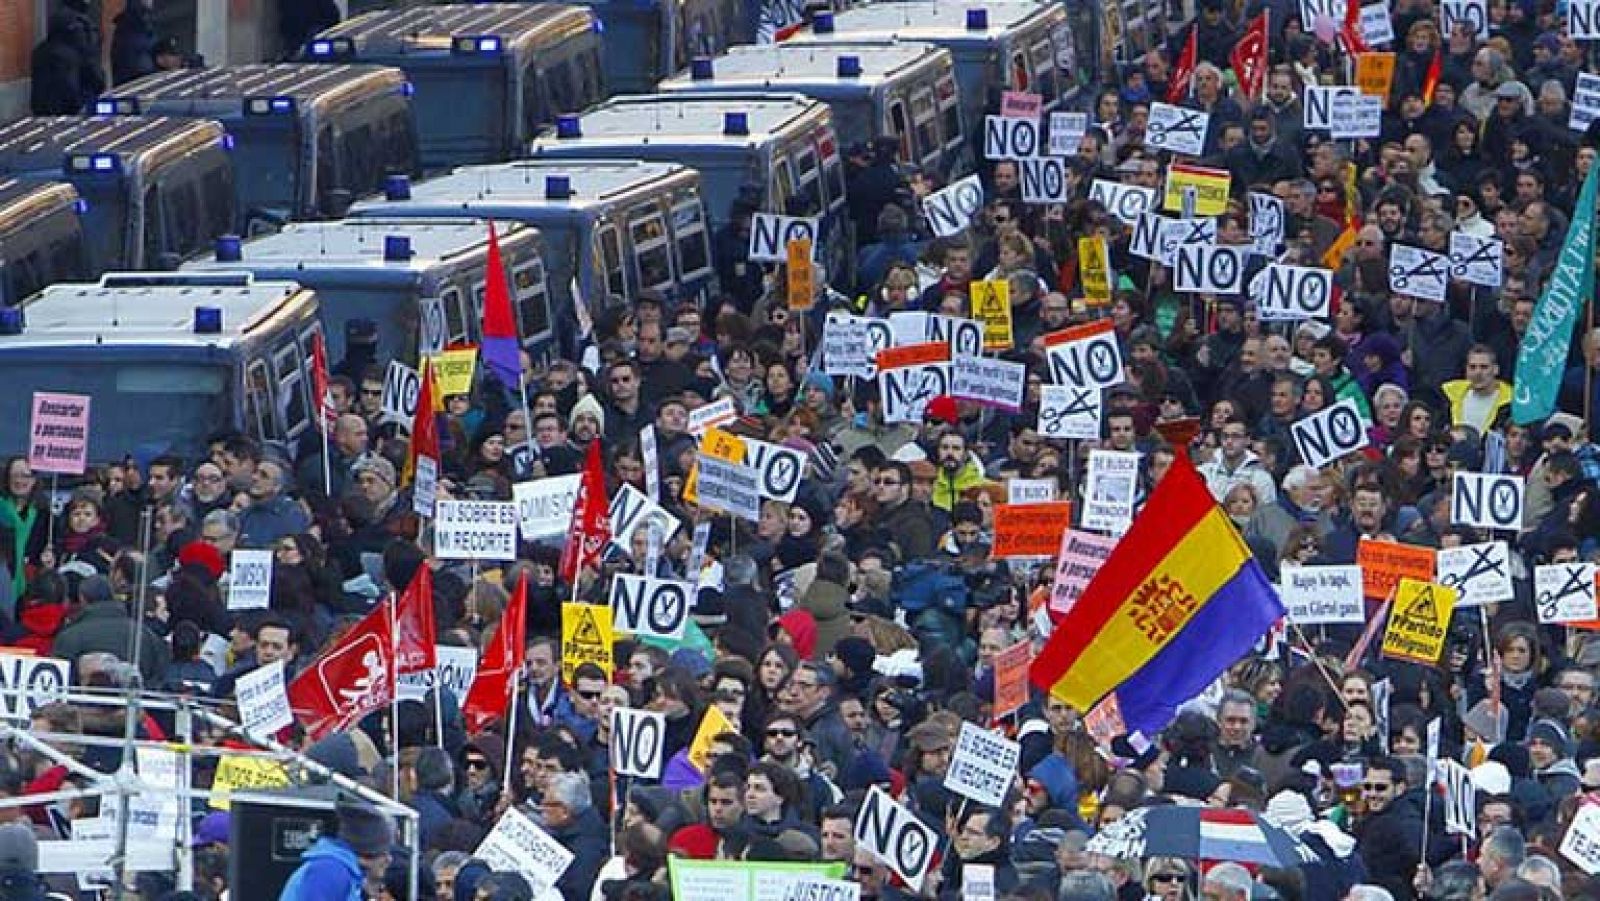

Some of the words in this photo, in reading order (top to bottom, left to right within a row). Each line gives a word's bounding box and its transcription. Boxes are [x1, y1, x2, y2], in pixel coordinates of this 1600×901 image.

[986, 119, 1036, 156] NO
[1023, 160, 1062, 198] NO
[926, 180, 982, 231] NO
[1178, 247, 1238, 289] NO
[1267, 266, 1327, 311] NO
[1051, 340, 1118, 388] NO
[385, 366, 419, 416] NO
[1296, 405, 1362, 466] NO
[440, 503, 453, 521] TU
[458, 503, 497, 523] SOBRE
[501, 504, 514, 524] ES
[1455, 475, 1520, 524] NO
[455, 532, 511, 552] RECORTE
[613, 578, 686, 634] NO
[615, 711, 660, 773] NO
[970, 735, 1005, 765] SOBRE
[1002, 748, 1017, 770] ES
[858, 790, 928, 878] NO
